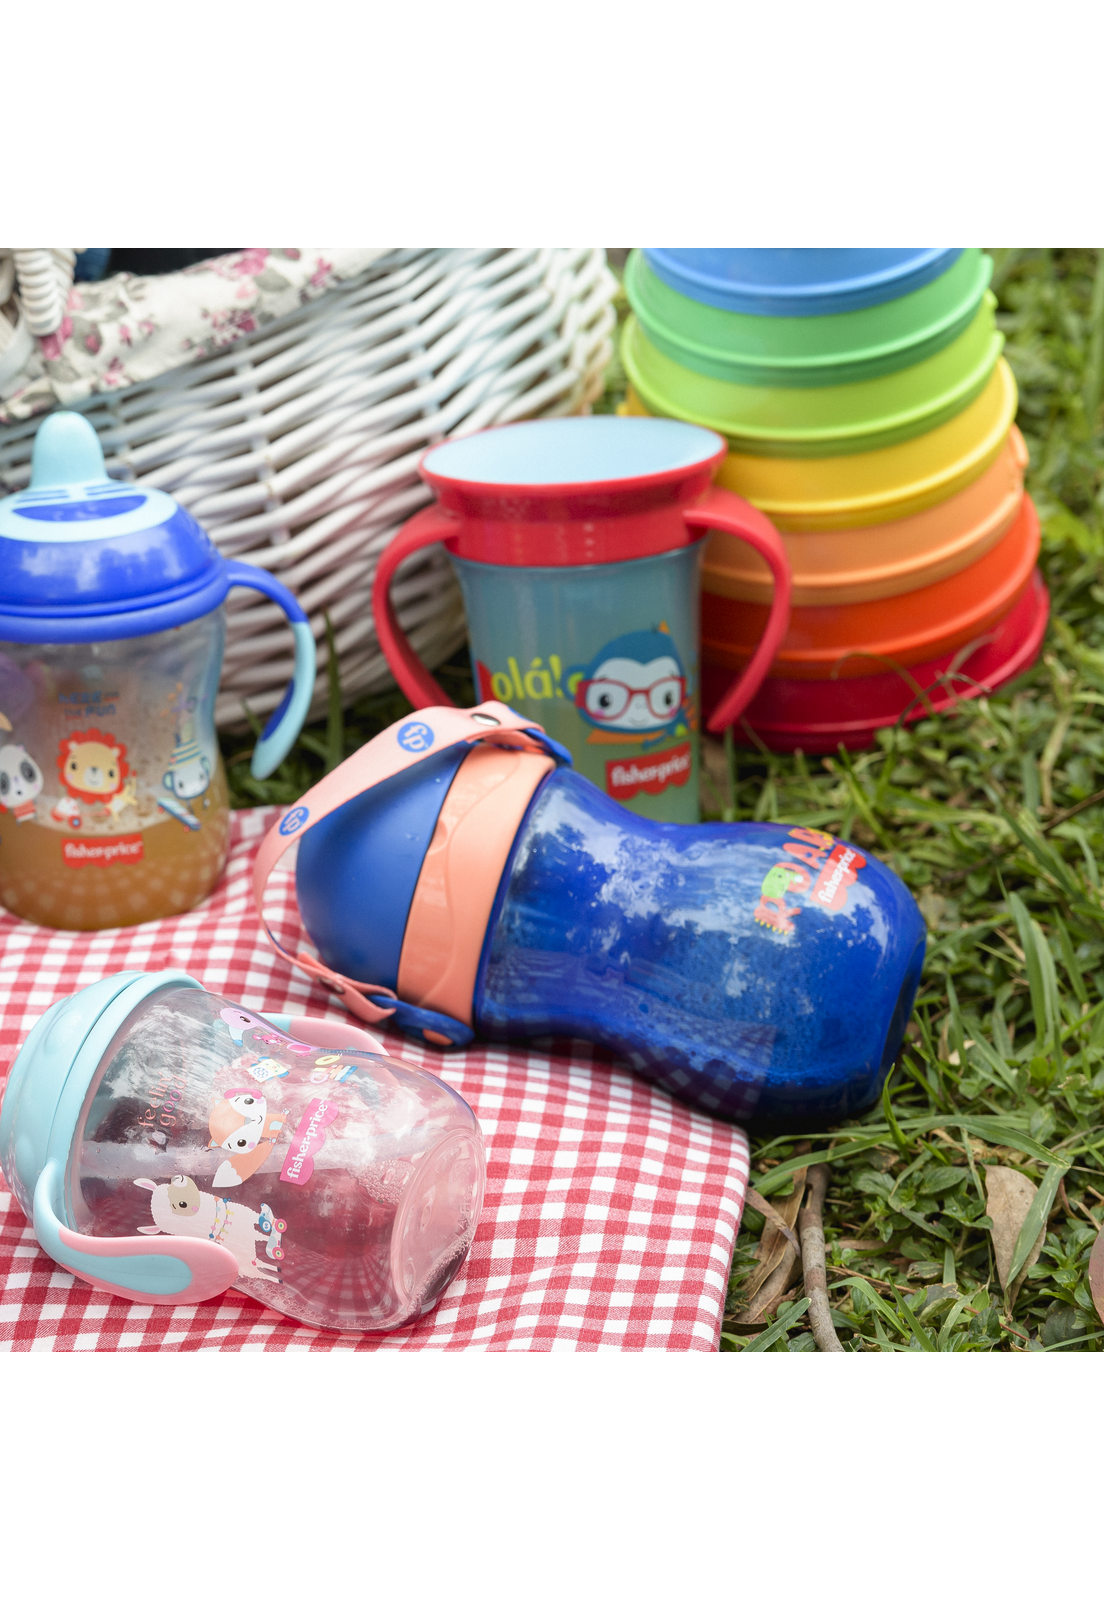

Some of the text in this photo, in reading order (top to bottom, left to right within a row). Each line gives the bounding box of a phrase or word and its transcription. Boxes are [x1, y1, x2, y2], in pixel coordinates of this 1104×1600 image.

[491, 654, 563, 702] olá!
[402, 724, 429, 749] fp
[283, 808, 304, 833] fp
[753, 827, 835, 936] ROAR
[817, 847, 857, 904] fisher-price
[138, 1071, 172, 1127] feelin'
[160, 1074, 188, 1126] good
[286, 1100, 328, 1179] fisher-price
